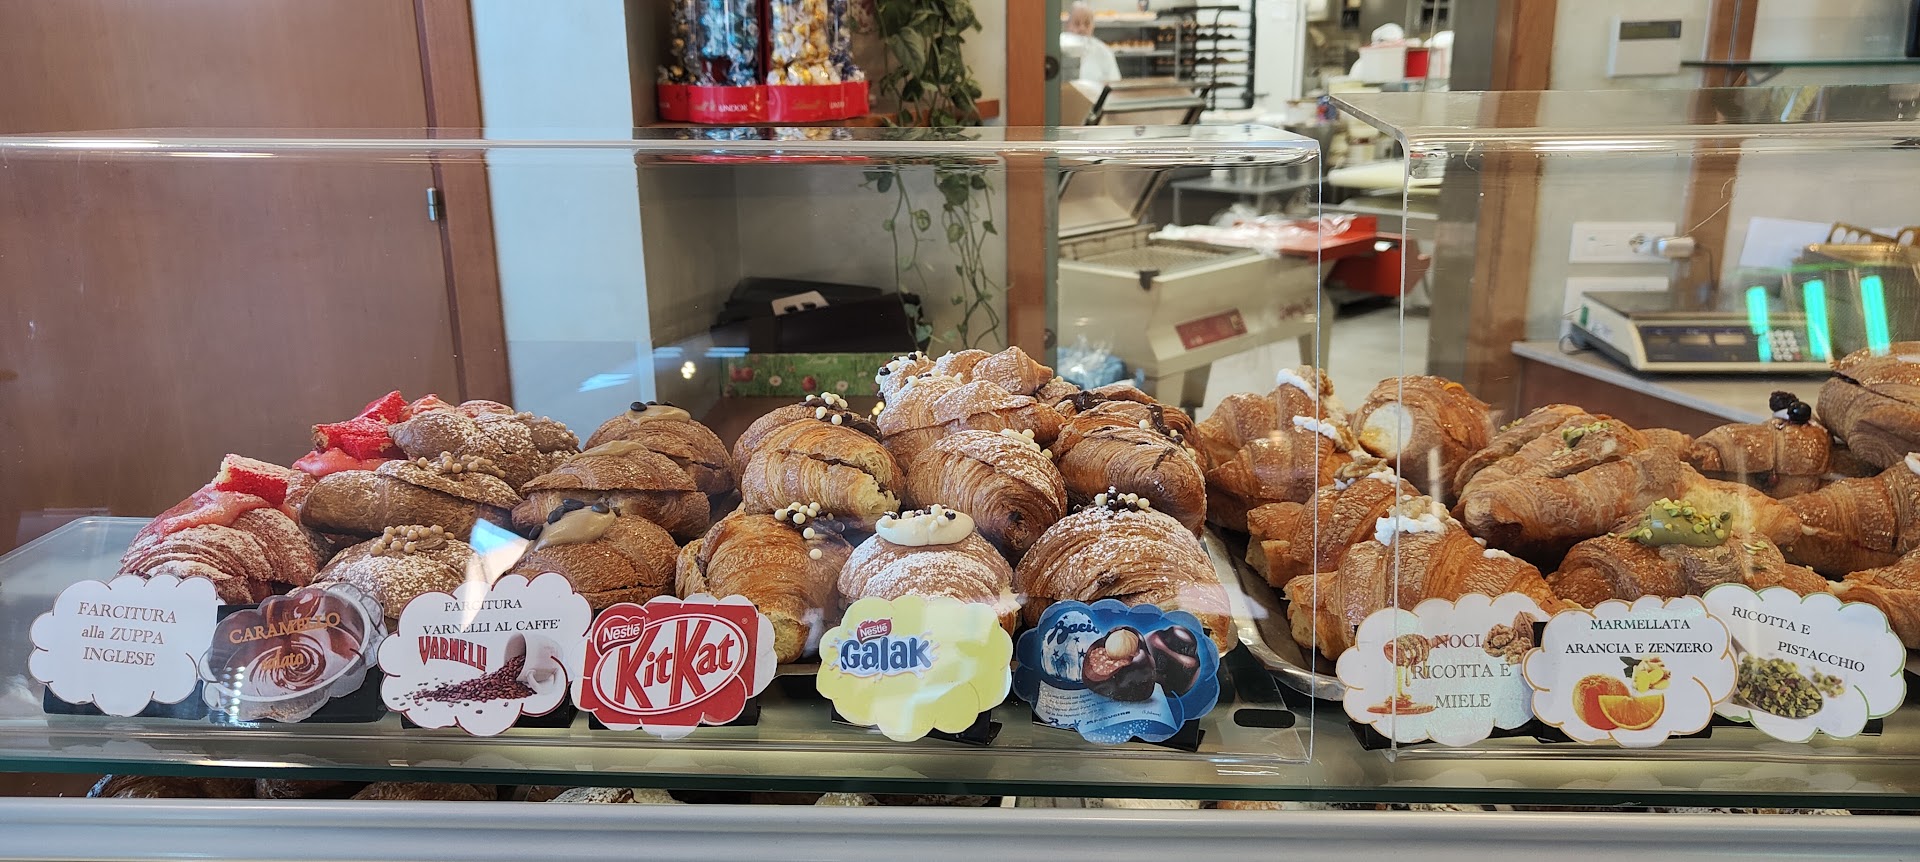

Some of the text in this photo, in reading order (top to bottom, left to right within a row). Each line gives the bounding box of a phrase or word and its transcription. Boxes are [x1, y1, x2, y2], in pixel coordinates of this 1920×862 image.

[77, 601, 177, 624] FARCITURA
[444, 599, 522, 612] FARCITURA
[229, 612, 341, 644] CARAMELLO
[423, 623, 490, 635] VARNELLI
[495, 621, 512, 632] AL
[1590, 619, 1691, 630] MARMELLATA
[1731, 606, 1811, 635] RICOTTA E
[81, 625, 164, 645] alla ZUPPA
[83, 646, 156, 666] INGLESE
[418, 636, 488, 672] VARNELLI
[840, 636, 932, 671] Galak
[1565, 642, 1713, 654] ARANCIA E ZENZERO
[1777, 641, 1865, 673] PISTACCHIO
[614, 619, 735, 708] KitKat
[1412, 663, 1512, 679] RICOTTA E
[1435, 693, 1492, 708] MIELE
